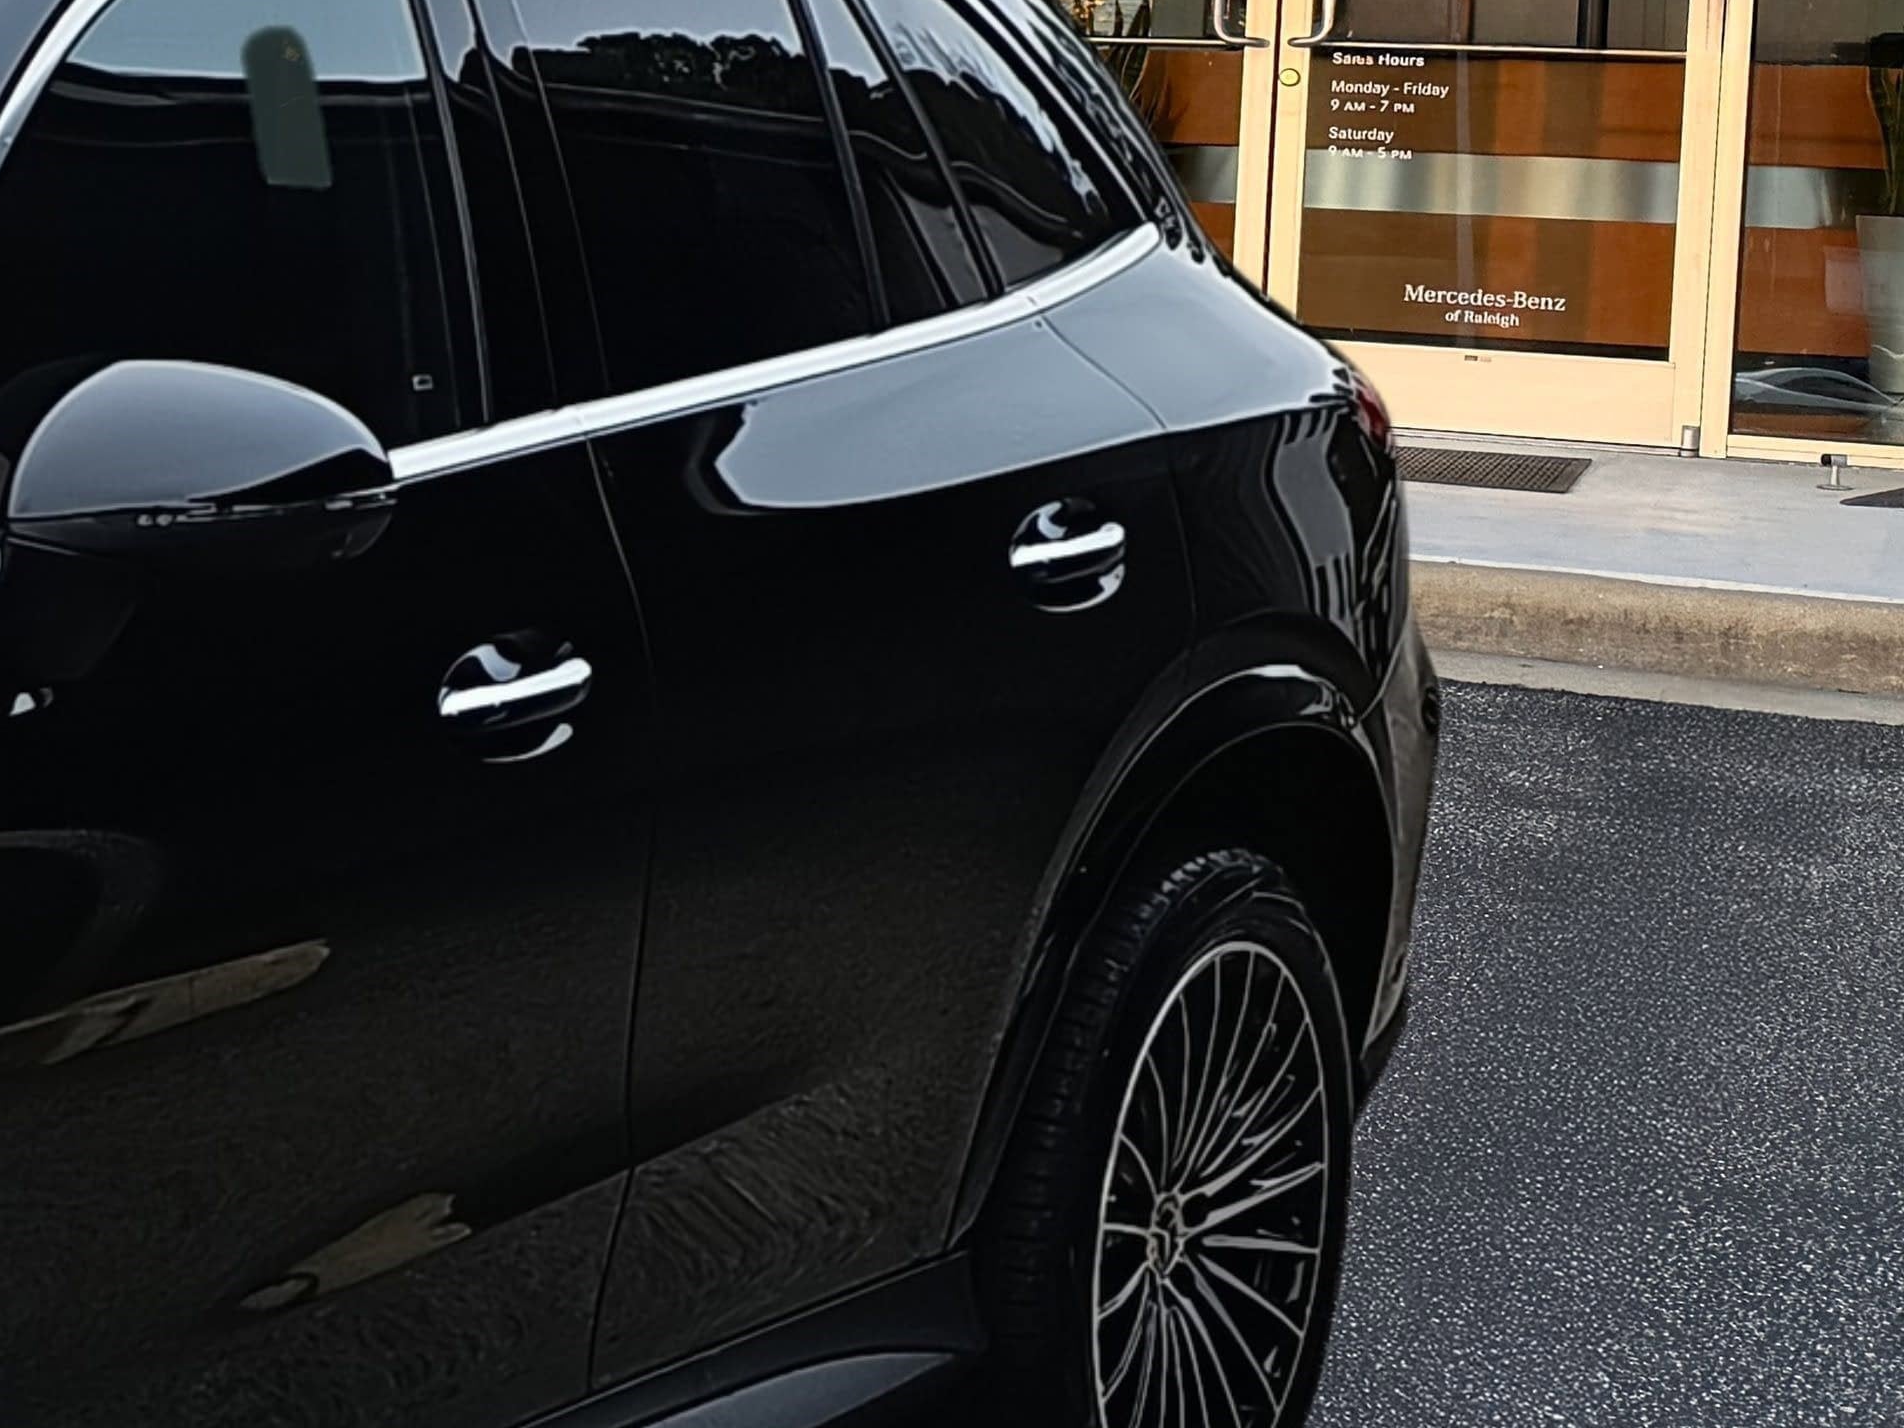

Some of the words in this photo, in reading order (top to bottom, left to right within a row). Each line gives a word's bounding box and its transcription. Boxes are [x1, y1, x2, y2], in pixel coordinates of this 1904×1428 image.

[1377, 53, 1425, 67] Hours
[1331, 79, 1390, 97] Monday
[1403, 81, 1449, 98] Friday
[1330, 98, 1340, 111] 9
[1343, 101, 1366, 112] AM
[1379, 99, 1389, 112] 7
[1393, 102, 1415, 113] PM
[1328, 126, 1394, 144] Saturday
[1328, 145, 1338, 157] 9
[1341, 147, 1364, 158] AM
[1377, 146, 1387, 159] 5
[1391, 149, 1413, 160] PM
[1403, 283, 1566, 312] Mercedes-Benz
[1445, 309, 1462, 323] of
[1464, 310, 1521, 328] Raleigh
